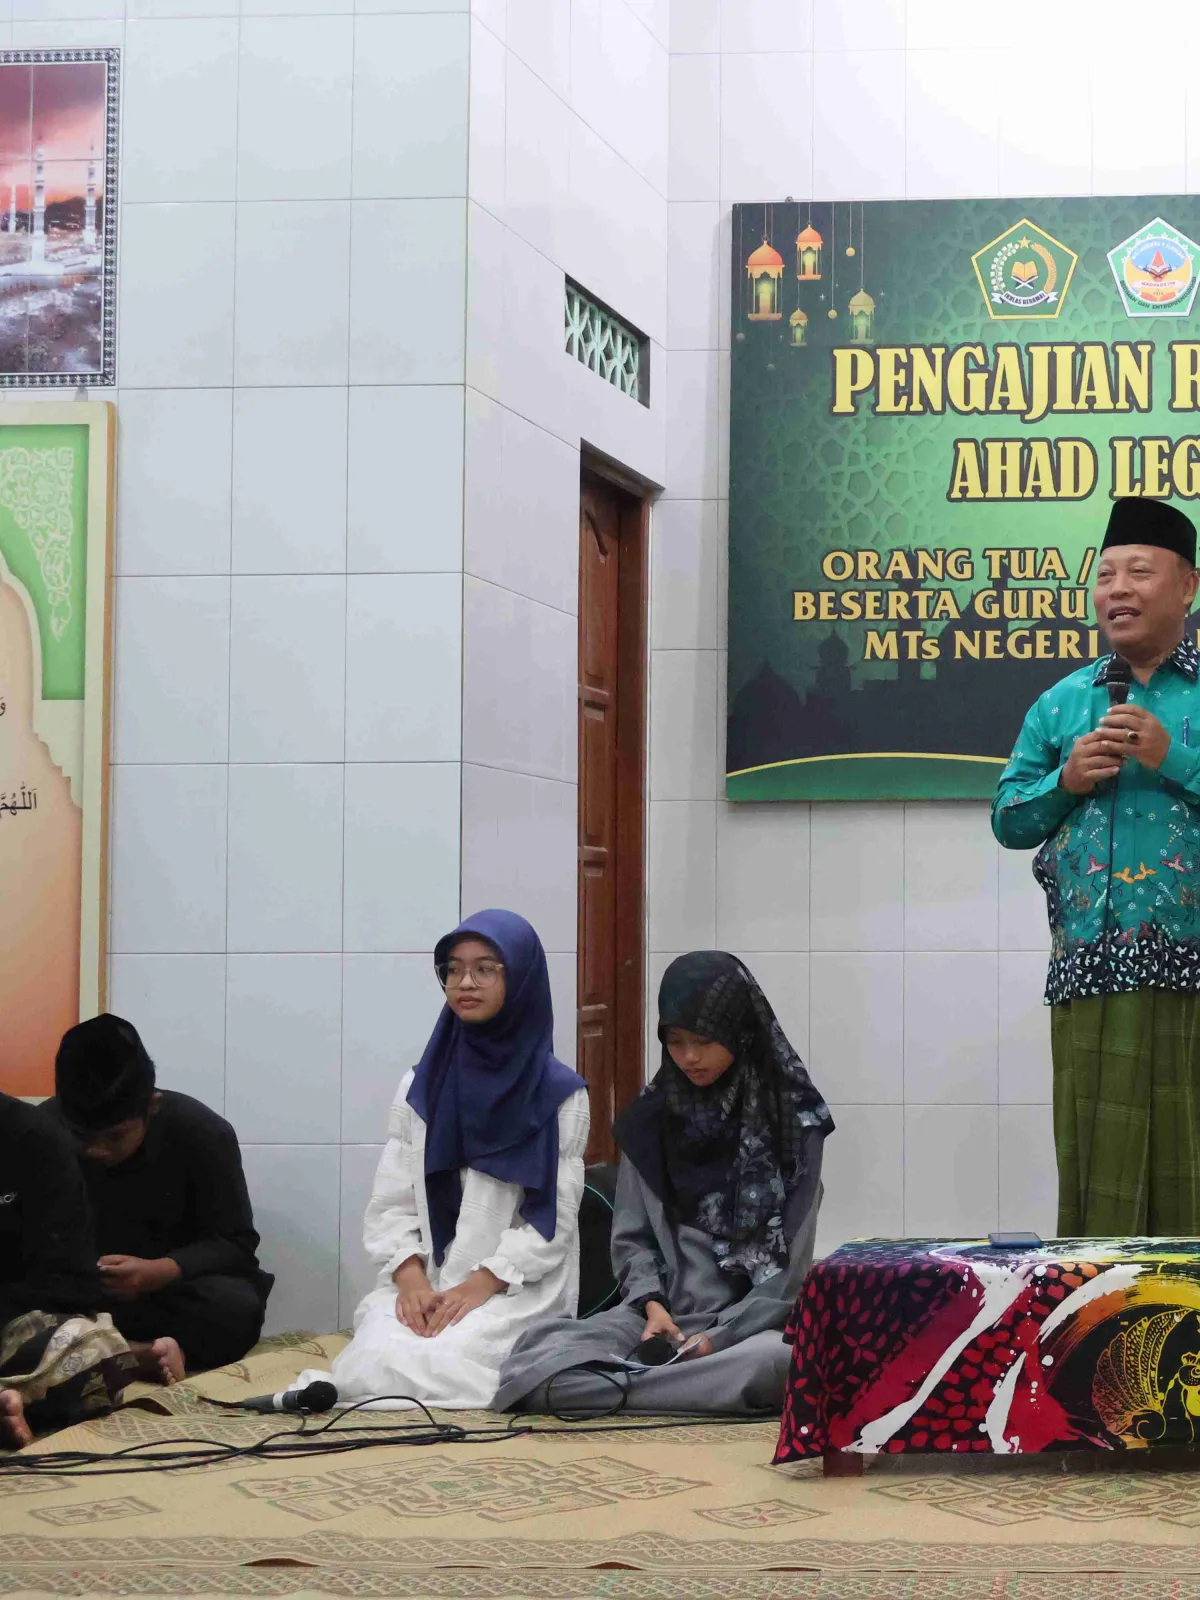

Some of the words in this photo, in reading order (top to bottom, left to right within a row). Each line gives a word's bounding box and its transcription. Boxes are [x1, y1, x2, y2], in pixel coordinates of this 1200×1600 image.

[832, 344, 1151, 420] PENGAJIAN
[951, 441, 1095, 498] AHAD
[823, 550, 972, 580] ORANG
[985, 549, 1066, 579] TUA
[794, 590, 960, 620] BESERTA
[974, 590, 1085, 619] GURU
[865, 631, 940, 659] MTs
[955, 630, 1098, 659] NEGERI
